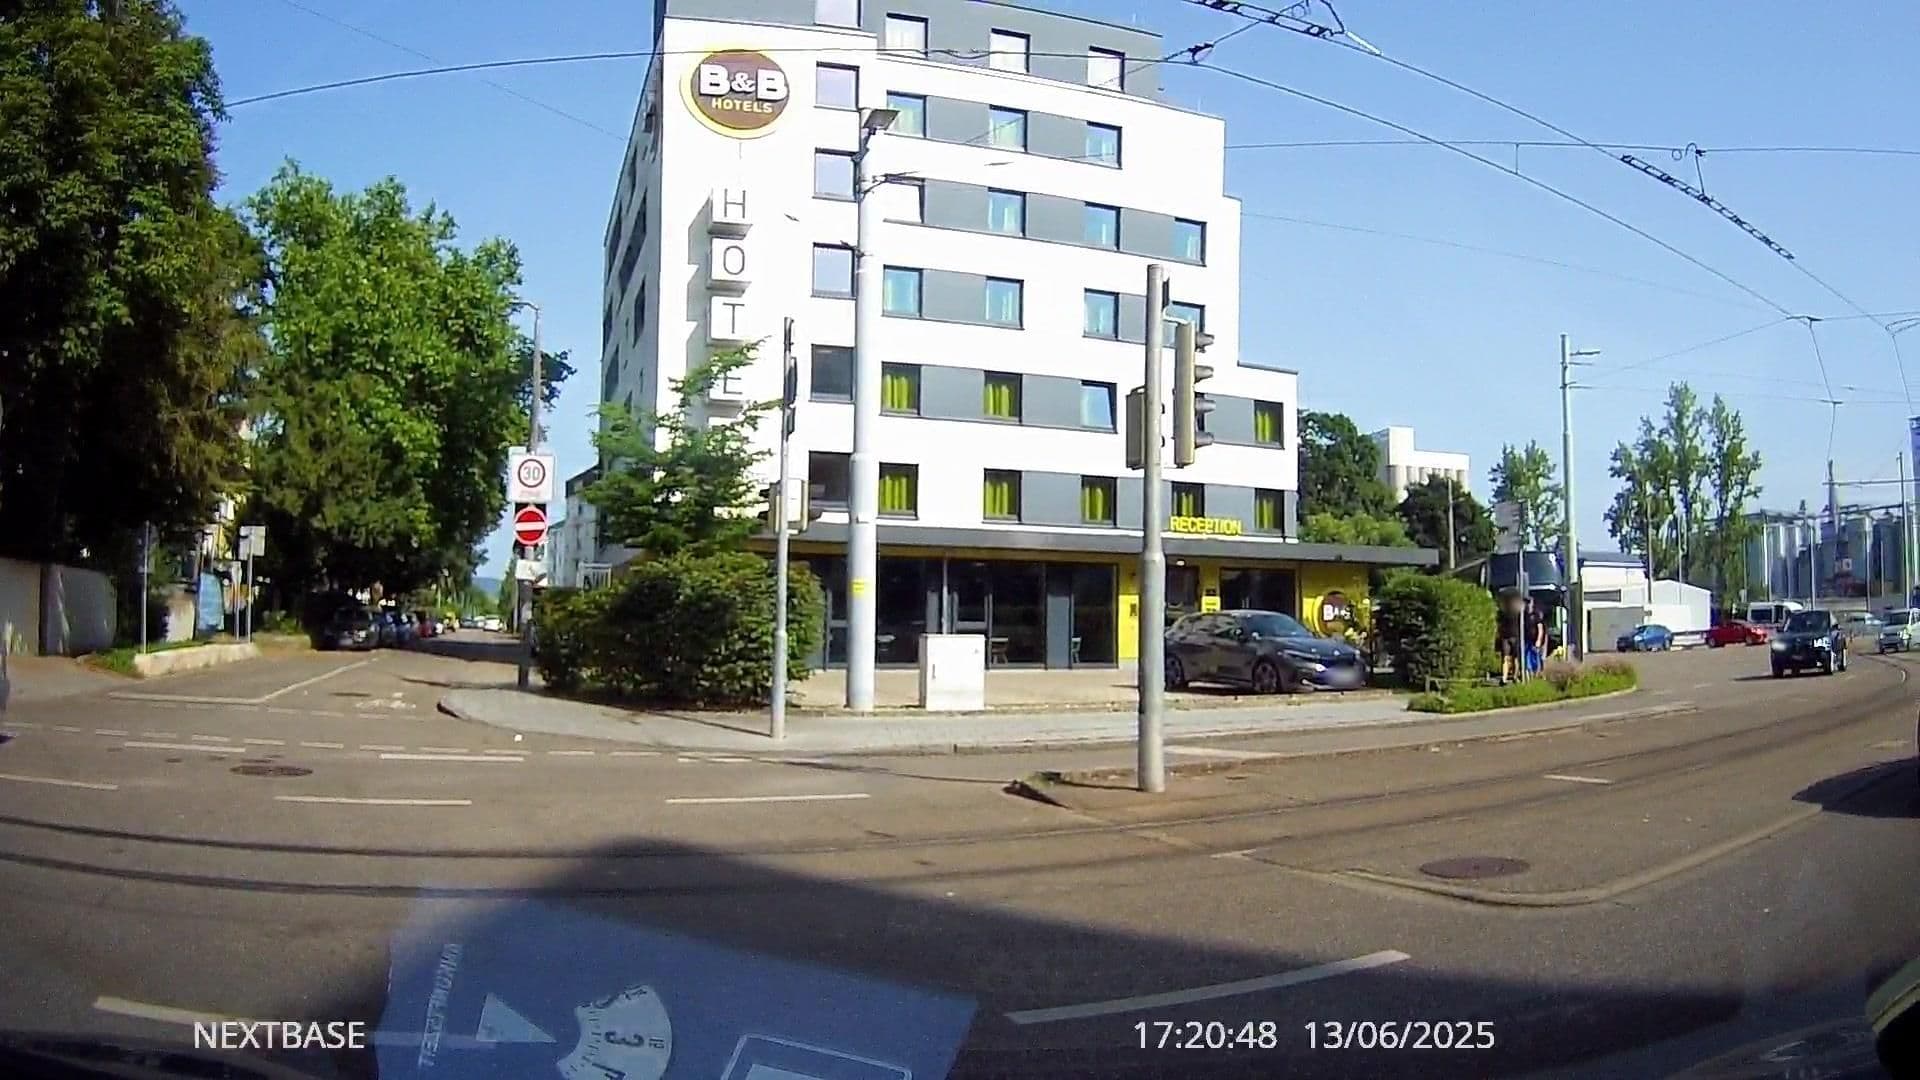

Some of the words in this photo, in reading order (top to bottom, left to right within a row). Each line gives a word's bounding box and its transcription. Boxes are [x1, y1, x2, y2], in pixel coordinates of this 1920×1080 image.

[699, 63, 788, 101] B&B
[711, 98, 773, 113] HOTELS
[721, 187, 747, 400] HOTE
[523, 466, 541, 481] 30
[1170, 516, 1242, 534] RECEPTION
